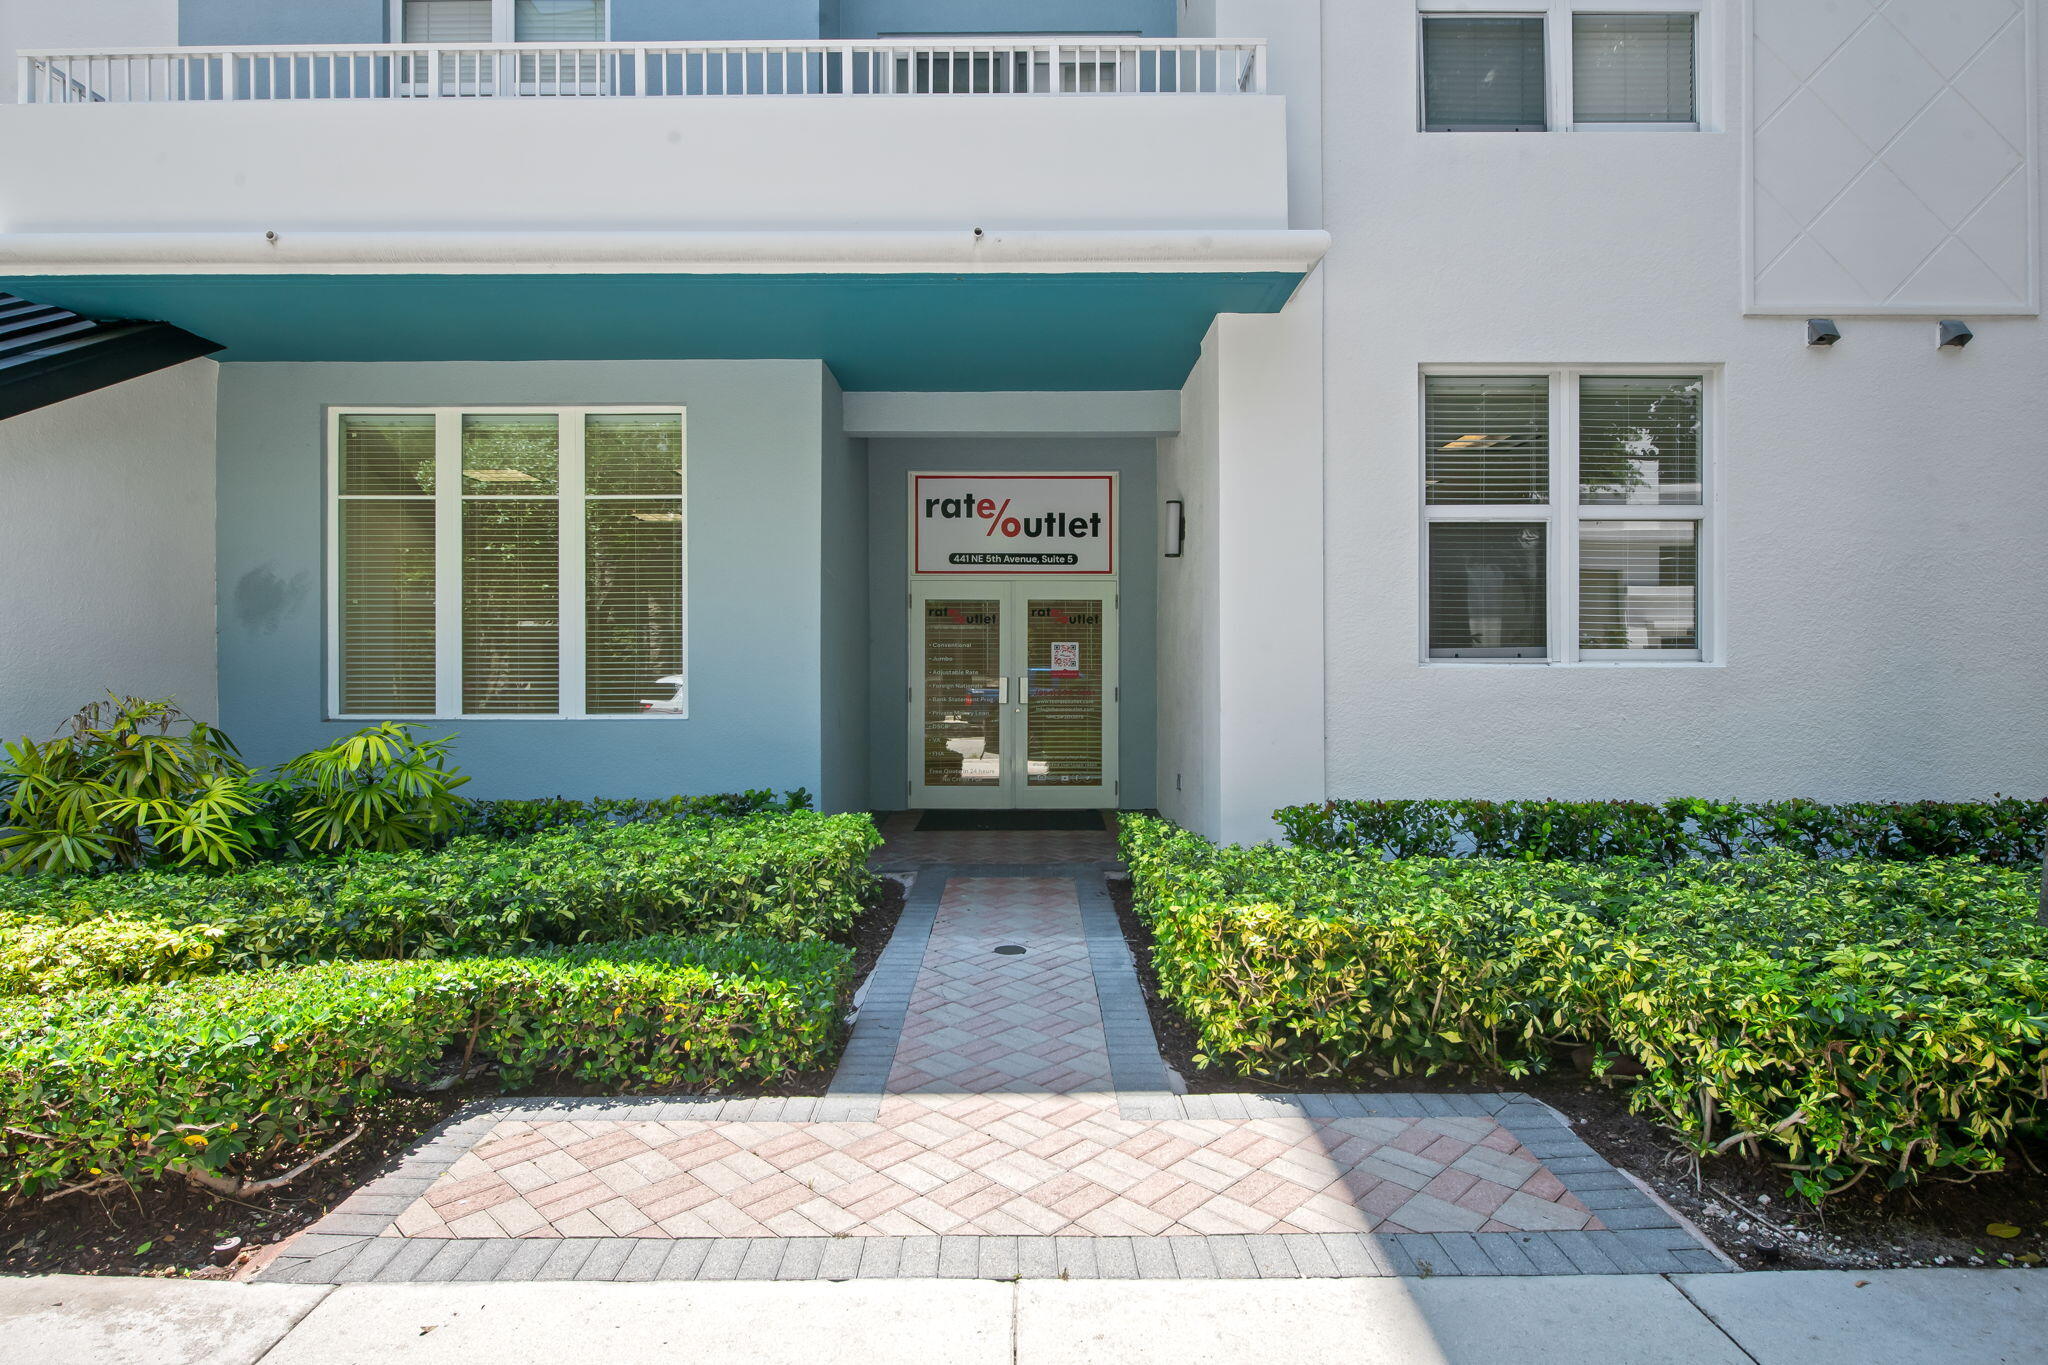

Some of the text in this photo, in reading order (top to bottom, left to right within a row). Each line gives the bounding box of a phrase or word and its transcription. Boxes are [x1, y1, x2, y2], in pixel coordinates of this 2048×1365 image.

[953, 554, 1074, 564] 441 NE 5th Avenue, Suite 5
